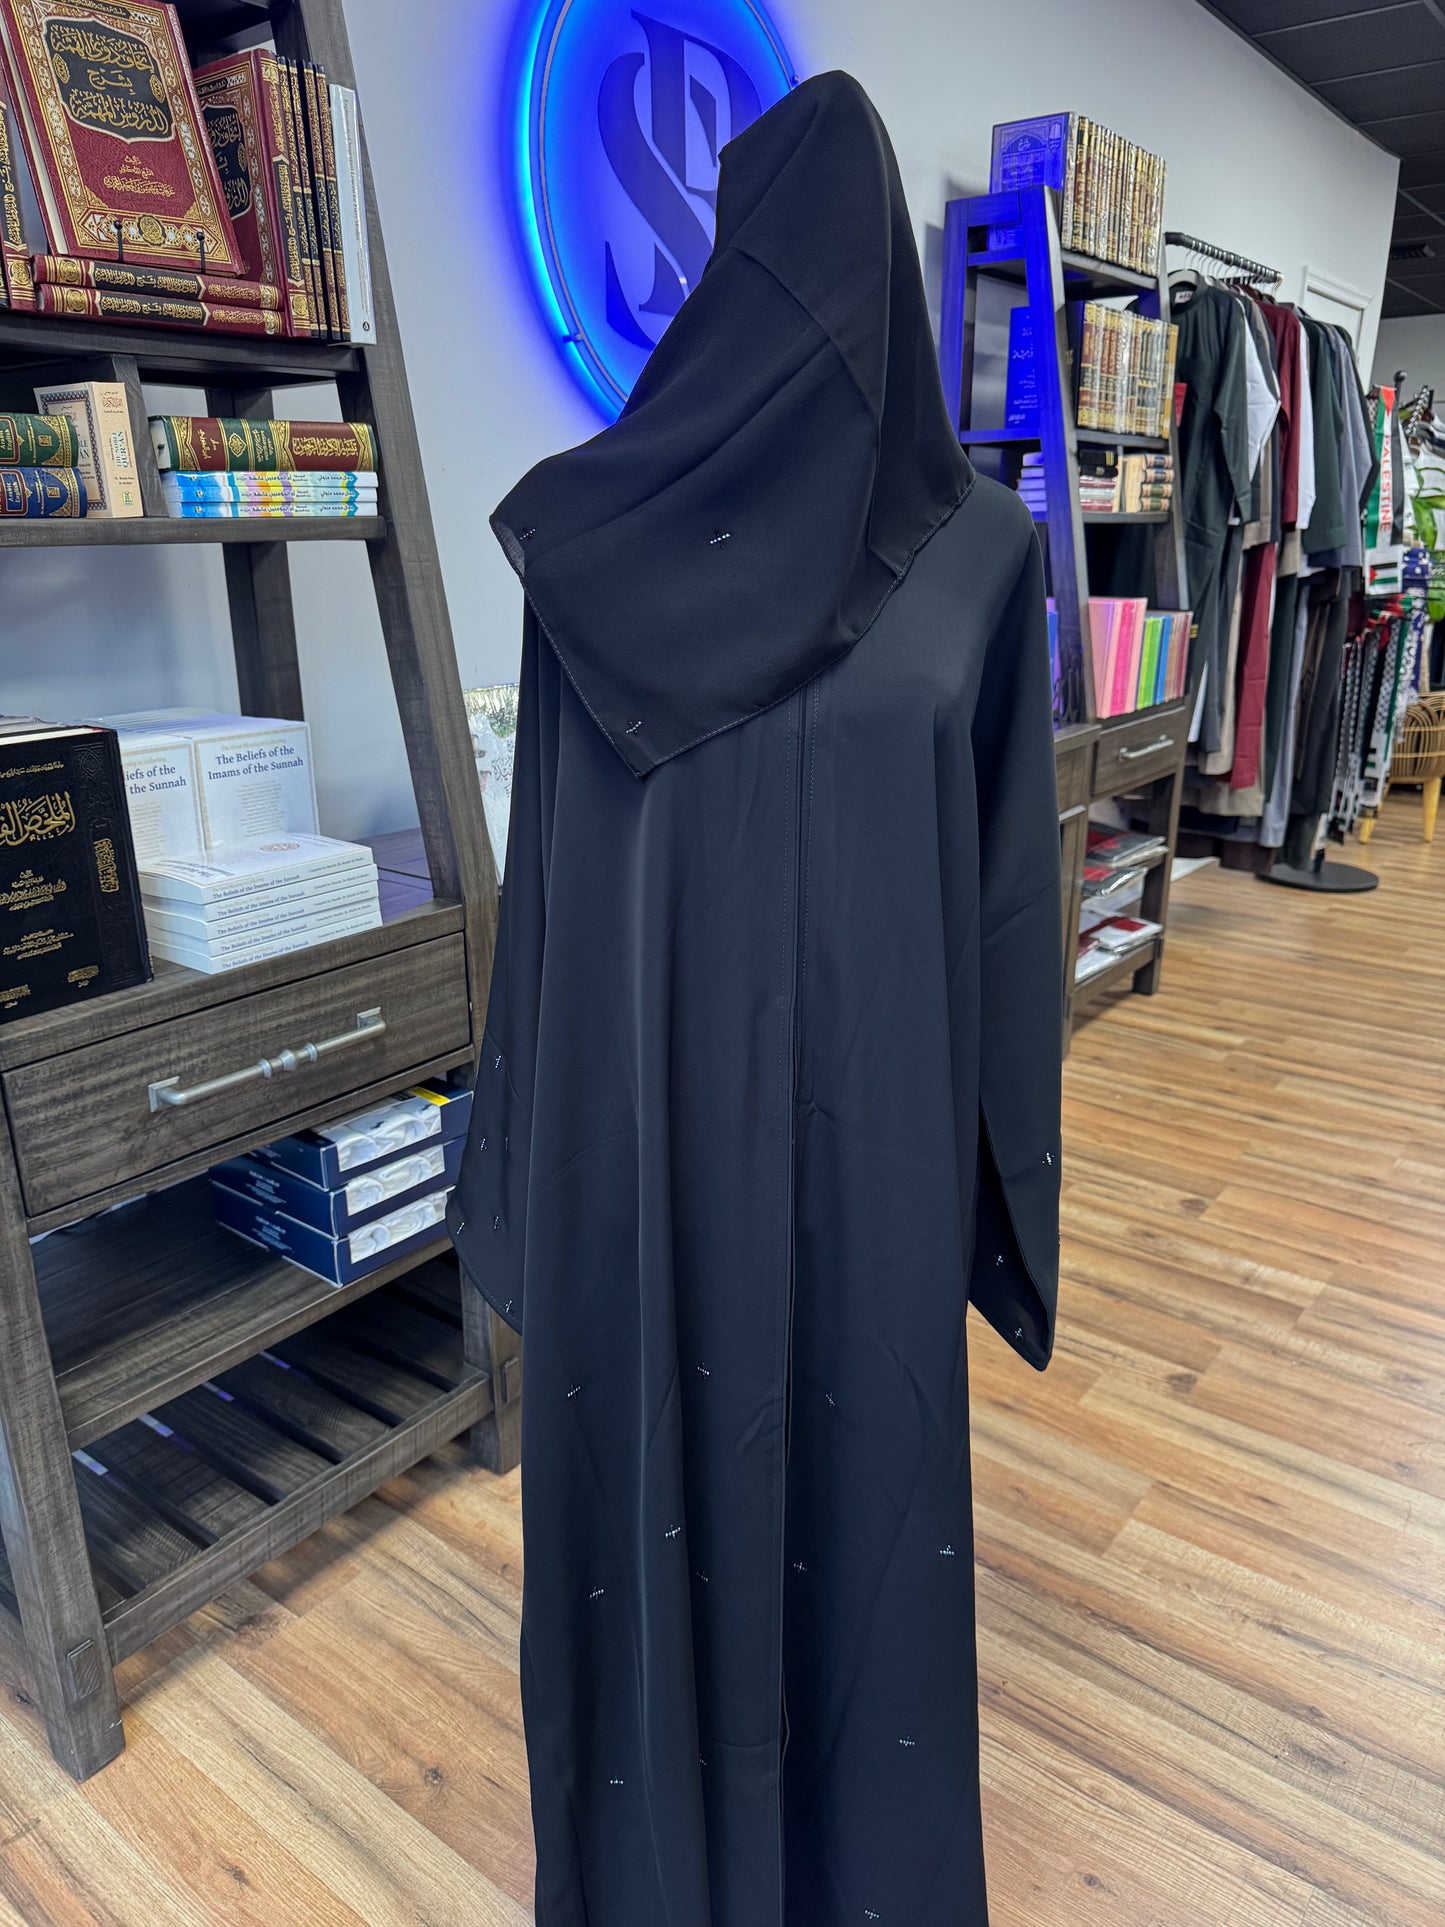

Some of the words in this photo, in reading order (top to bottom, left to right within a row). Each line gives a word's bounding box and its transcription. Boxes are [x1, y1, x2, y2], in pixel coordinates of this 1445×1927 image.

[1381, 434, 1392, 532] PALESTINE
[216, 755, 233, 765] The
[237, 749, 267, 762] Beliefs
[269, 746, 279, 757] of
[280, 746, 294, 756] the
[125, 768, 145, 781] iefs
[147, 766, 158, 778] of
[160, 765, 176, 776] the
[208, 769, 241, 780] Imams
[243, 764, 252, 775] of
[254, 762, 269, 772] the
[271, 757, 303, 771] Sunnah
[130, 783, 146, 794] the
[149, 776, 186, 791] Sunnah
